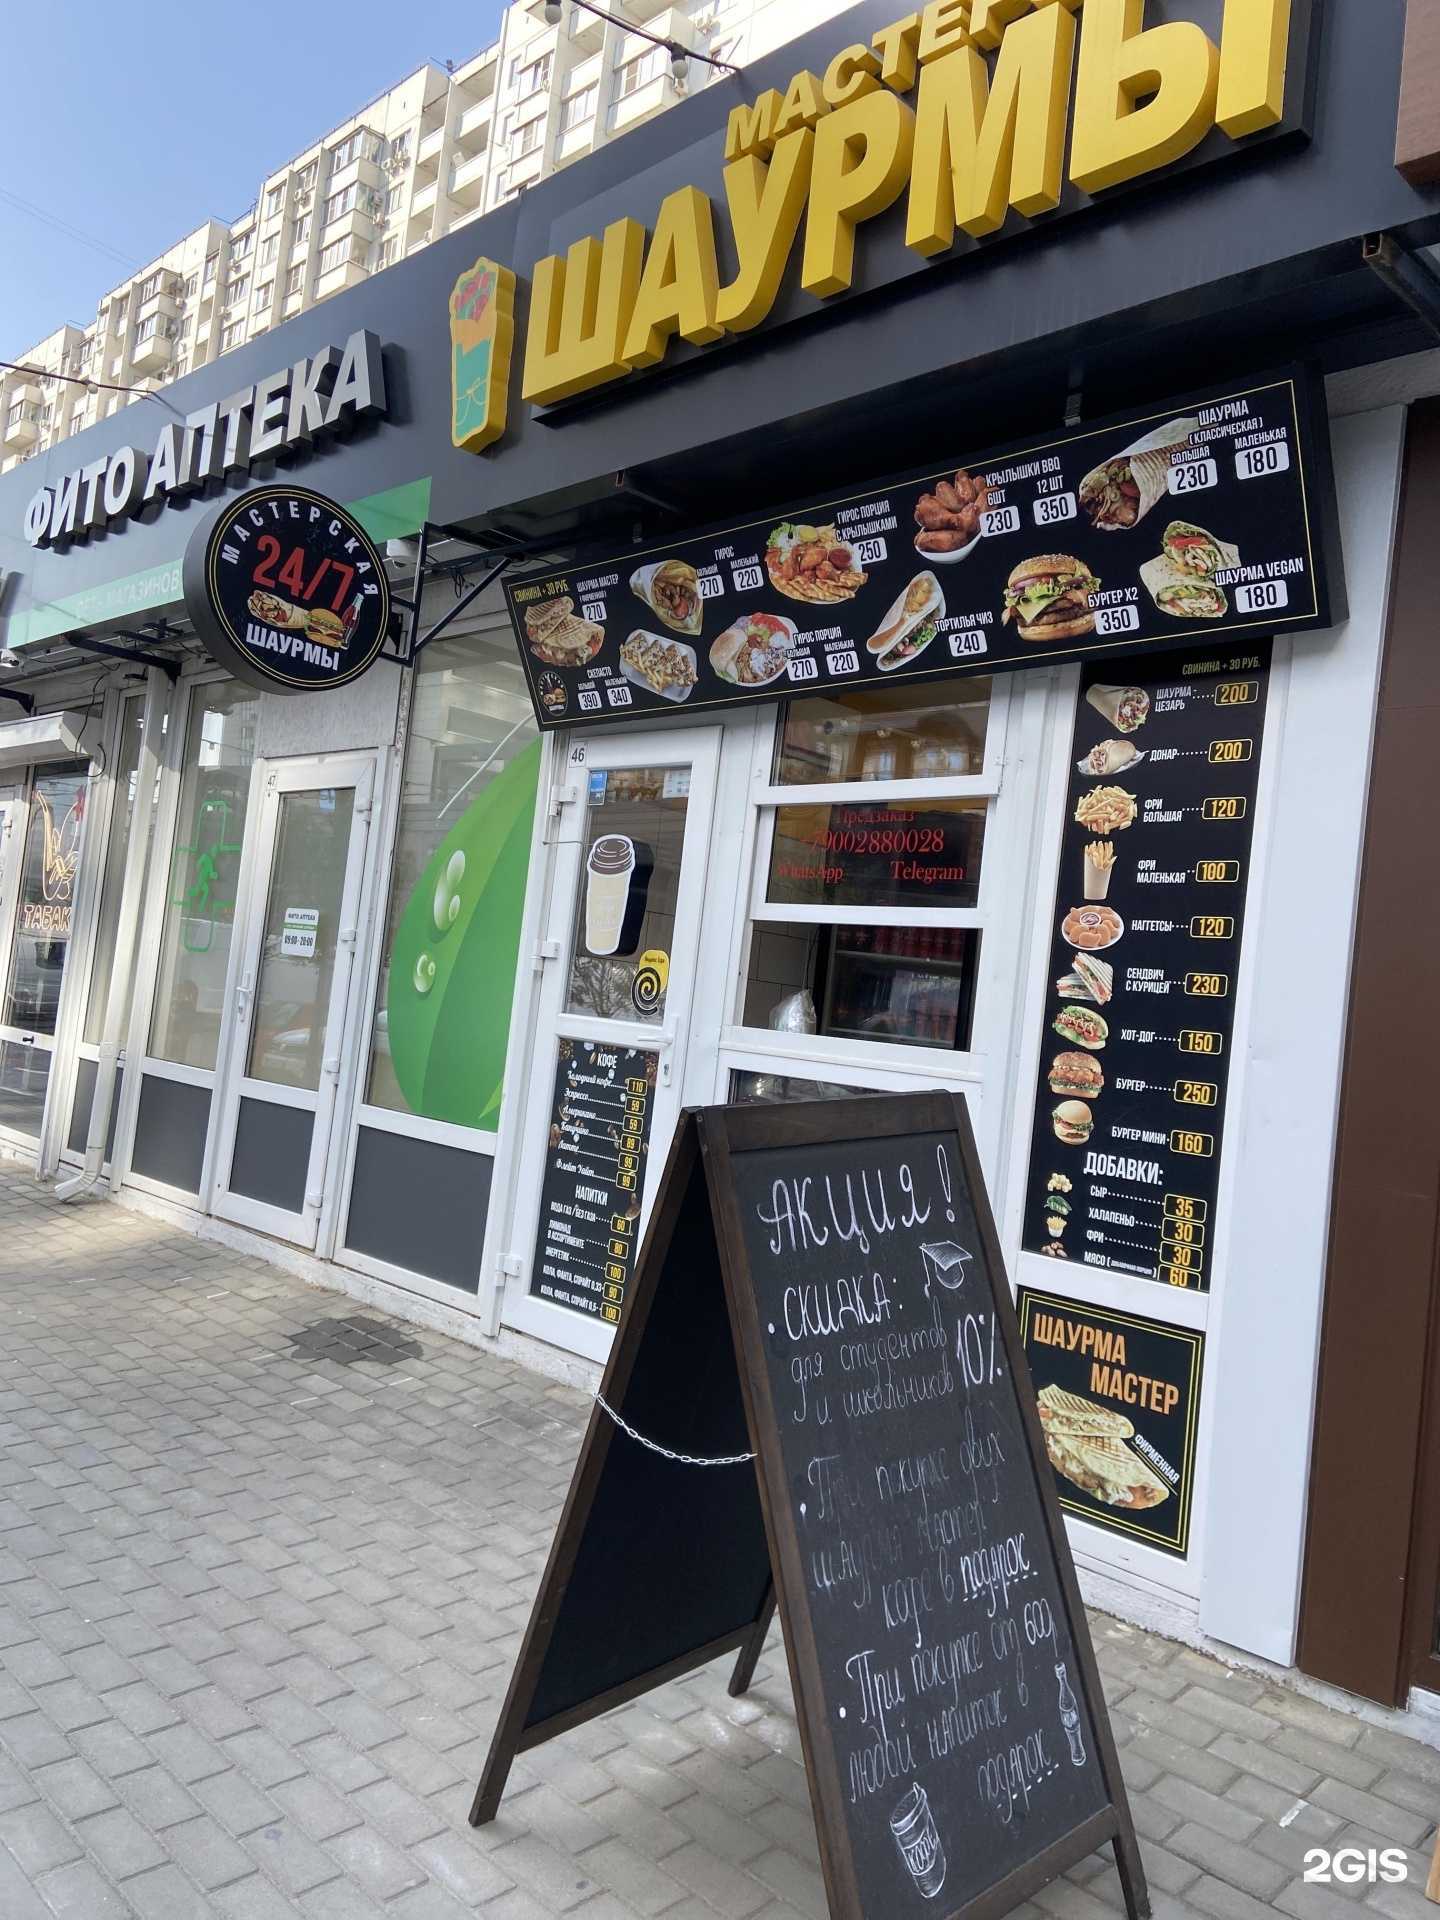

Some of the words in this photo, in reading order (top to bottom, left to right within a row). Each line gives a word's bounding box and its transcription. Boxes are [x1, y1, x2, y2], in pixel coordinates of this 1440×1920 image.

[522, 0, 1291, 407] ШАУРМЫ
[1199, 400, 1249, 425] ШАУРМА
[24, 444, 147, 548] ФИТО
[143, 328, 386, 501] АПТЕКА
[1171, 445, 1210, 465] БОЛЬШАЯ
[1235, 427, 1287, 449] МАЛЕНЬКАЯ
[986, 461, 1040, 487] КРЫЛЫШКИ
[1041, 456, 1061, 475] BBQ
[1175, 463, 1209, 491] 230
[1245, 446, 1278, 475] 180
[1036, 479, 1047, 494] 12
[1048, 475, 1064, 491] ШТ
[837, 508, 860, 524] ГИРОС
[860, 499, 890, 520] ПОРЦИЯ
[986, 510, 1013, 533] 230
[1040, 496, 1069, 522] 350
[843, 516, 898, 541] КРЫЛЫШКАМИ
[222, 501, 378, 595] МАСТЕРСКАЯ
[715, 545, 735, 561] ГИРОС
[858, 541, 882, 562] 250
[253, 535, 354, 611] 24/7
[701, 577, 719, 597] 270
[738, 569, 759, 589] 220
[1215, 567, 1264, 586] ШАУРМА
[1266, 557, 1304, 578] VEGAN
[1088, 589, 1123, 607] БУРГЕР
[1245, 583, 1277, 609] 180
[586, 603, 604, 622] 270
[935, 615, 975, 632] ТОРТИЛЬЯ
[976, 611, 993, 628] ЧИЗ
[1100, 608, 1131, 632] 350
[246, 624, 340, 671] ШАУРМЫ
[793, 631, 814, 645] ГИРОС
[815, 626, 842, 642] ПОРЦИЯ
[955, 634, 980, 653] 240
[792, 660, 813, 678] 270
[832, 653, 854, 673] 220
[1182, 661, 1220, 675] СВИНИНА
[1230, 658, 1241, 670] 30
[582, 693, 598, 708] 390
[612, 688, 628, 704] 340
[1155, 700, 1185, 712] ЦЕЗАРЬ
[1156, 686, 1192, 700] ШАУРМА
[1220, 684, 1249, 703] 200
[571, 747, 585, 763] 46
[1150, 749, 1178, 762] ДОНАР
[1214, 742, 1242, 760] 200
[1143, 810, 1182, 822] БОЛЬШАЯ
[1211, 799, 1236, 818] 120
[1144, 798, 1163, 810] ФРИ
[889, 859, 964, 884] Telegram
[1138, 859, 1156, 871] ФРИ
[1136, 872, 1185, 884] МАЛЕНЬКАЯ
[24, 904, 71, 931] ТАБАК
[1131, 919, 1172, 932] НАГГЕТСЫ
[1199, 918, 1225, 936] 120
[1125, 980, 1131, 991] С
[1132, 979, 1170, 994] КУРИЦЕЙ
[1192, 975, 1219, 994] 230
[1127, 968, 1164, 980] СЕНДВИЧ
[1121, 1029, 1155, 1043] ХОТ-ДОГ
[1188, 1034, 1213, 1052] 150
[1116, 1077, 1145, 1092] БУРГЕР
[1183, 1084, 1210, 1103] 250
[1112, 1126, 1141, 1141] БУРГЕР
[1142, 1131, 1166, 1145] МИНИ
[1177, 1133, 1202, 1153] 160
[1083, 1151, 1164, 1186] ДОБАВКИ:
[575, 1184, 608, 1206] НАПИТКИ
[1090, 1185, 1108, 1199] СЫР
[1175, 1198, 1194, 1219] 35
[1088, 1207, 1135, 1227] ХАЛАПЕНЬО
[1175, 1222, 1193, 1242] 30
[1086, 1230, 1104, 1244] ФРИ
[1173, 1246, 1191, 1266] 30
[1084, 1251, 1106, 1266] МЯСО
[1169, 1267, 1187, 1287] 60
[956, 1311, 1003, 1388] 10%
[1033, 1312, 1126, 1366] ШАУРМА
[1090, 1363, 1180, 1416] МАСТЕР
[1134, 1433, 1180, 1484] ФИРМЕННАЯ
[959, 1533, 1031, 1618] подарок
[846, 1649, 906, 1742] При
[910, 1631, 984, 1708] покупке
[976, 1728, 1052, 1824] подарок
